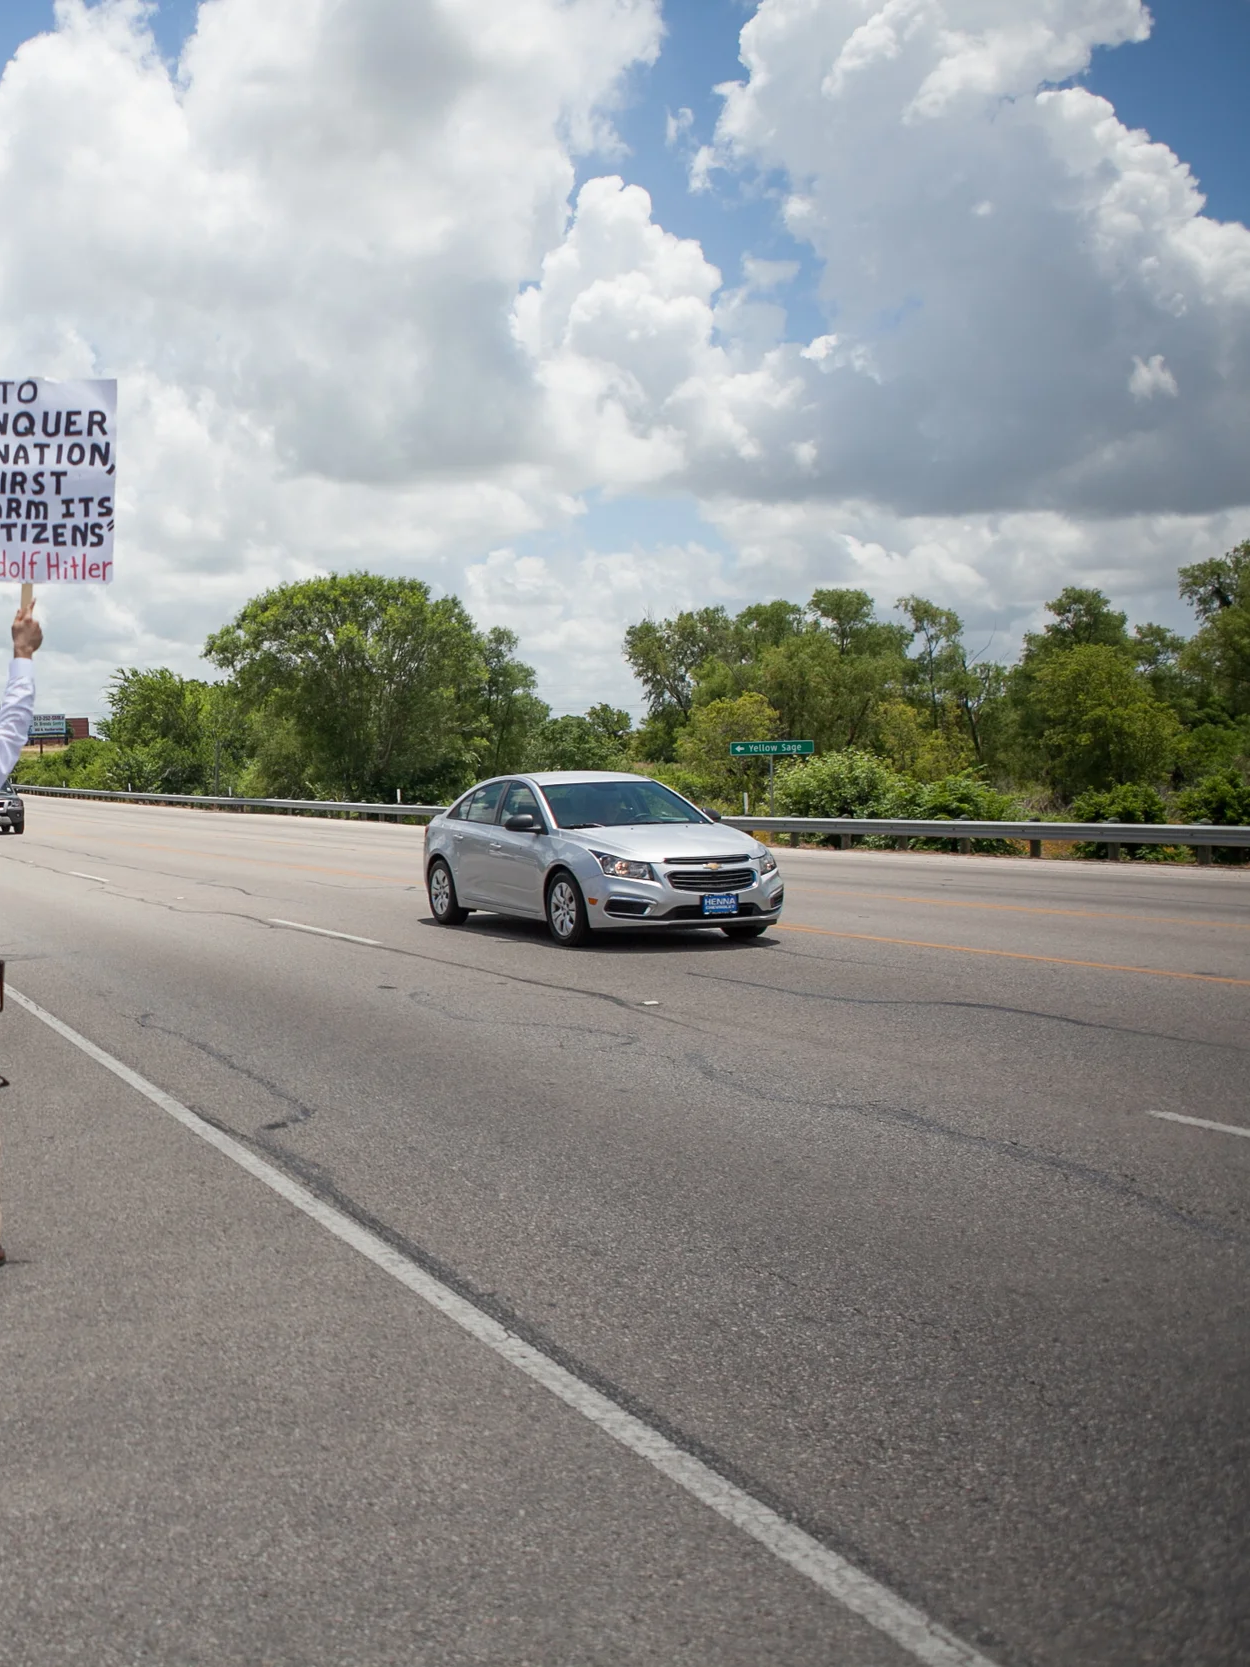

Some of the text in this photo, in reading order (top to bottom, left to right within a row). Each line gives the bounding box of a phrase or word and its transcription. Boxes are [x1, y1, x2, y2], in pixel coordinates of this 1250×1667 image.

[61, 496, 114, 519] ITS
[46, 551, 113, 581] Hitler
[749, 743, 802, 753] Yellow Sage
[704, 897, 736, 906] HENNA
